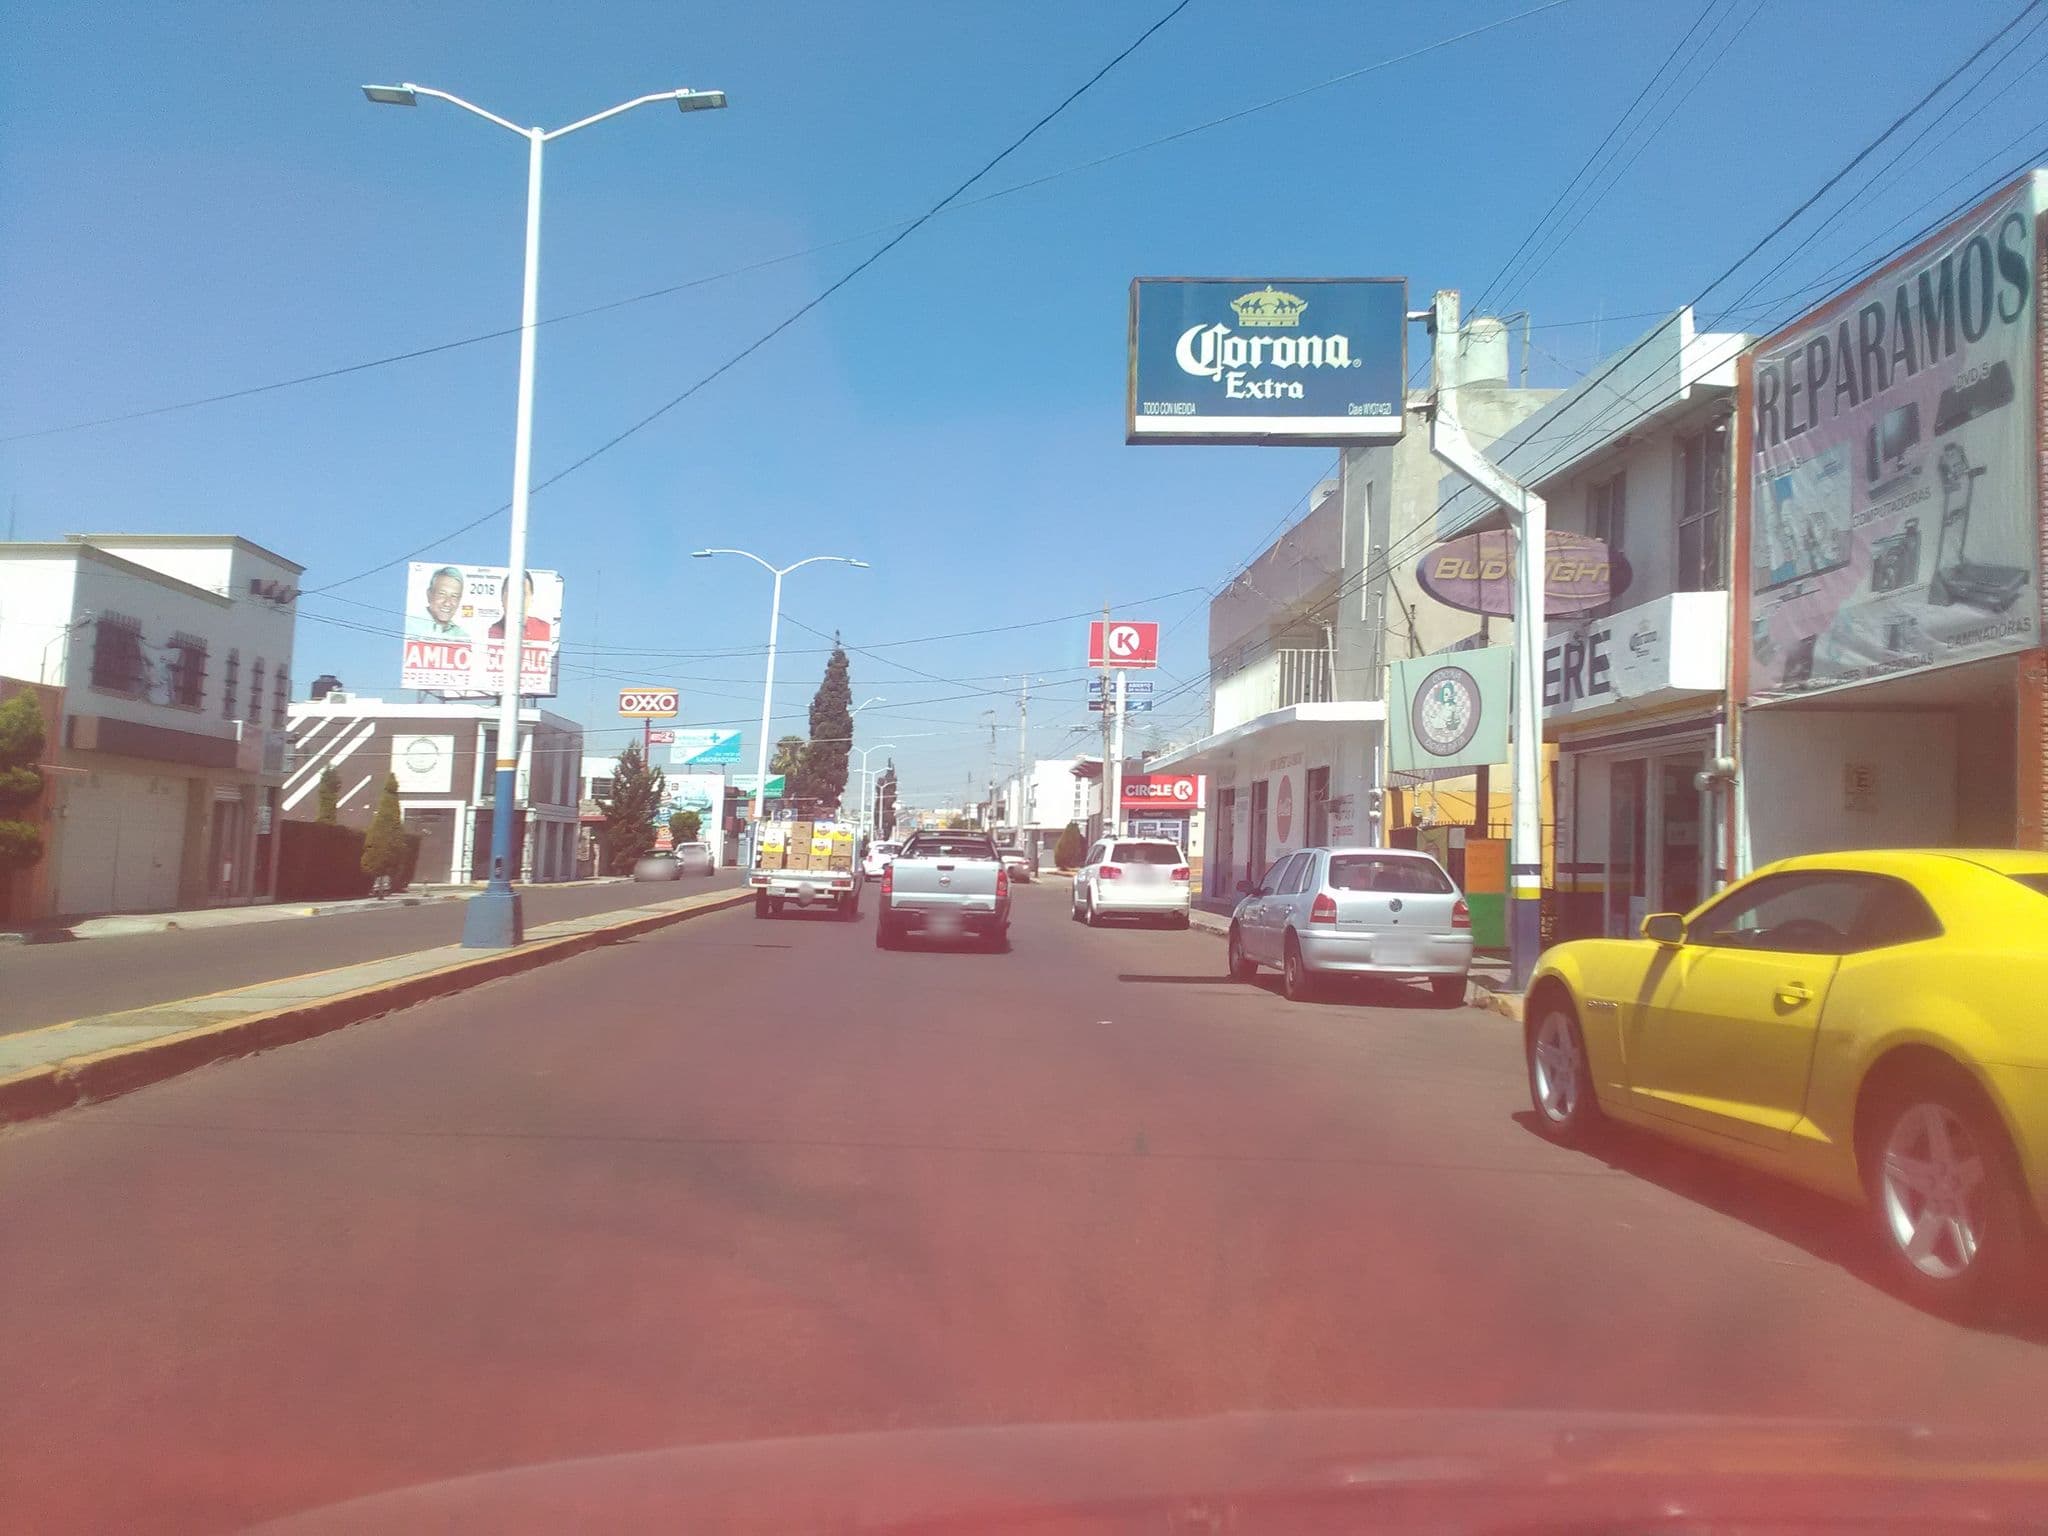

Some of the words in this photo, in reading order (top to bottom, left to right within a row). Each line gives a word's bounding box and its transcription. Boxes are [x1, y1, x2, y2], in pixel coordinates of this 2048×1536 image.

[1756, 211, 2030, 453] REPARAMOS
[1176, 322, 1351, 382] Corona
[1225, 371, 1304, 399] Extra
[1143, 402, 1160, 415] TODO
[1161, 402, 1173, 415] CON
[1174, 402, 1197, 415] MEDIDA
[1434, 558, 1508, 580] BUD
[470, 583, 495, 595] 2018
[1117, 632, 1138, 655] K
[1945, 616, 2033, 649] CAMINADORAS
[406, 645, 472, 670] AMLO
[621, 695, 676, 712] OXXO
[1125, 783, 1173, 798] CIRCLE
[1179, 784, 1191, 797] K
